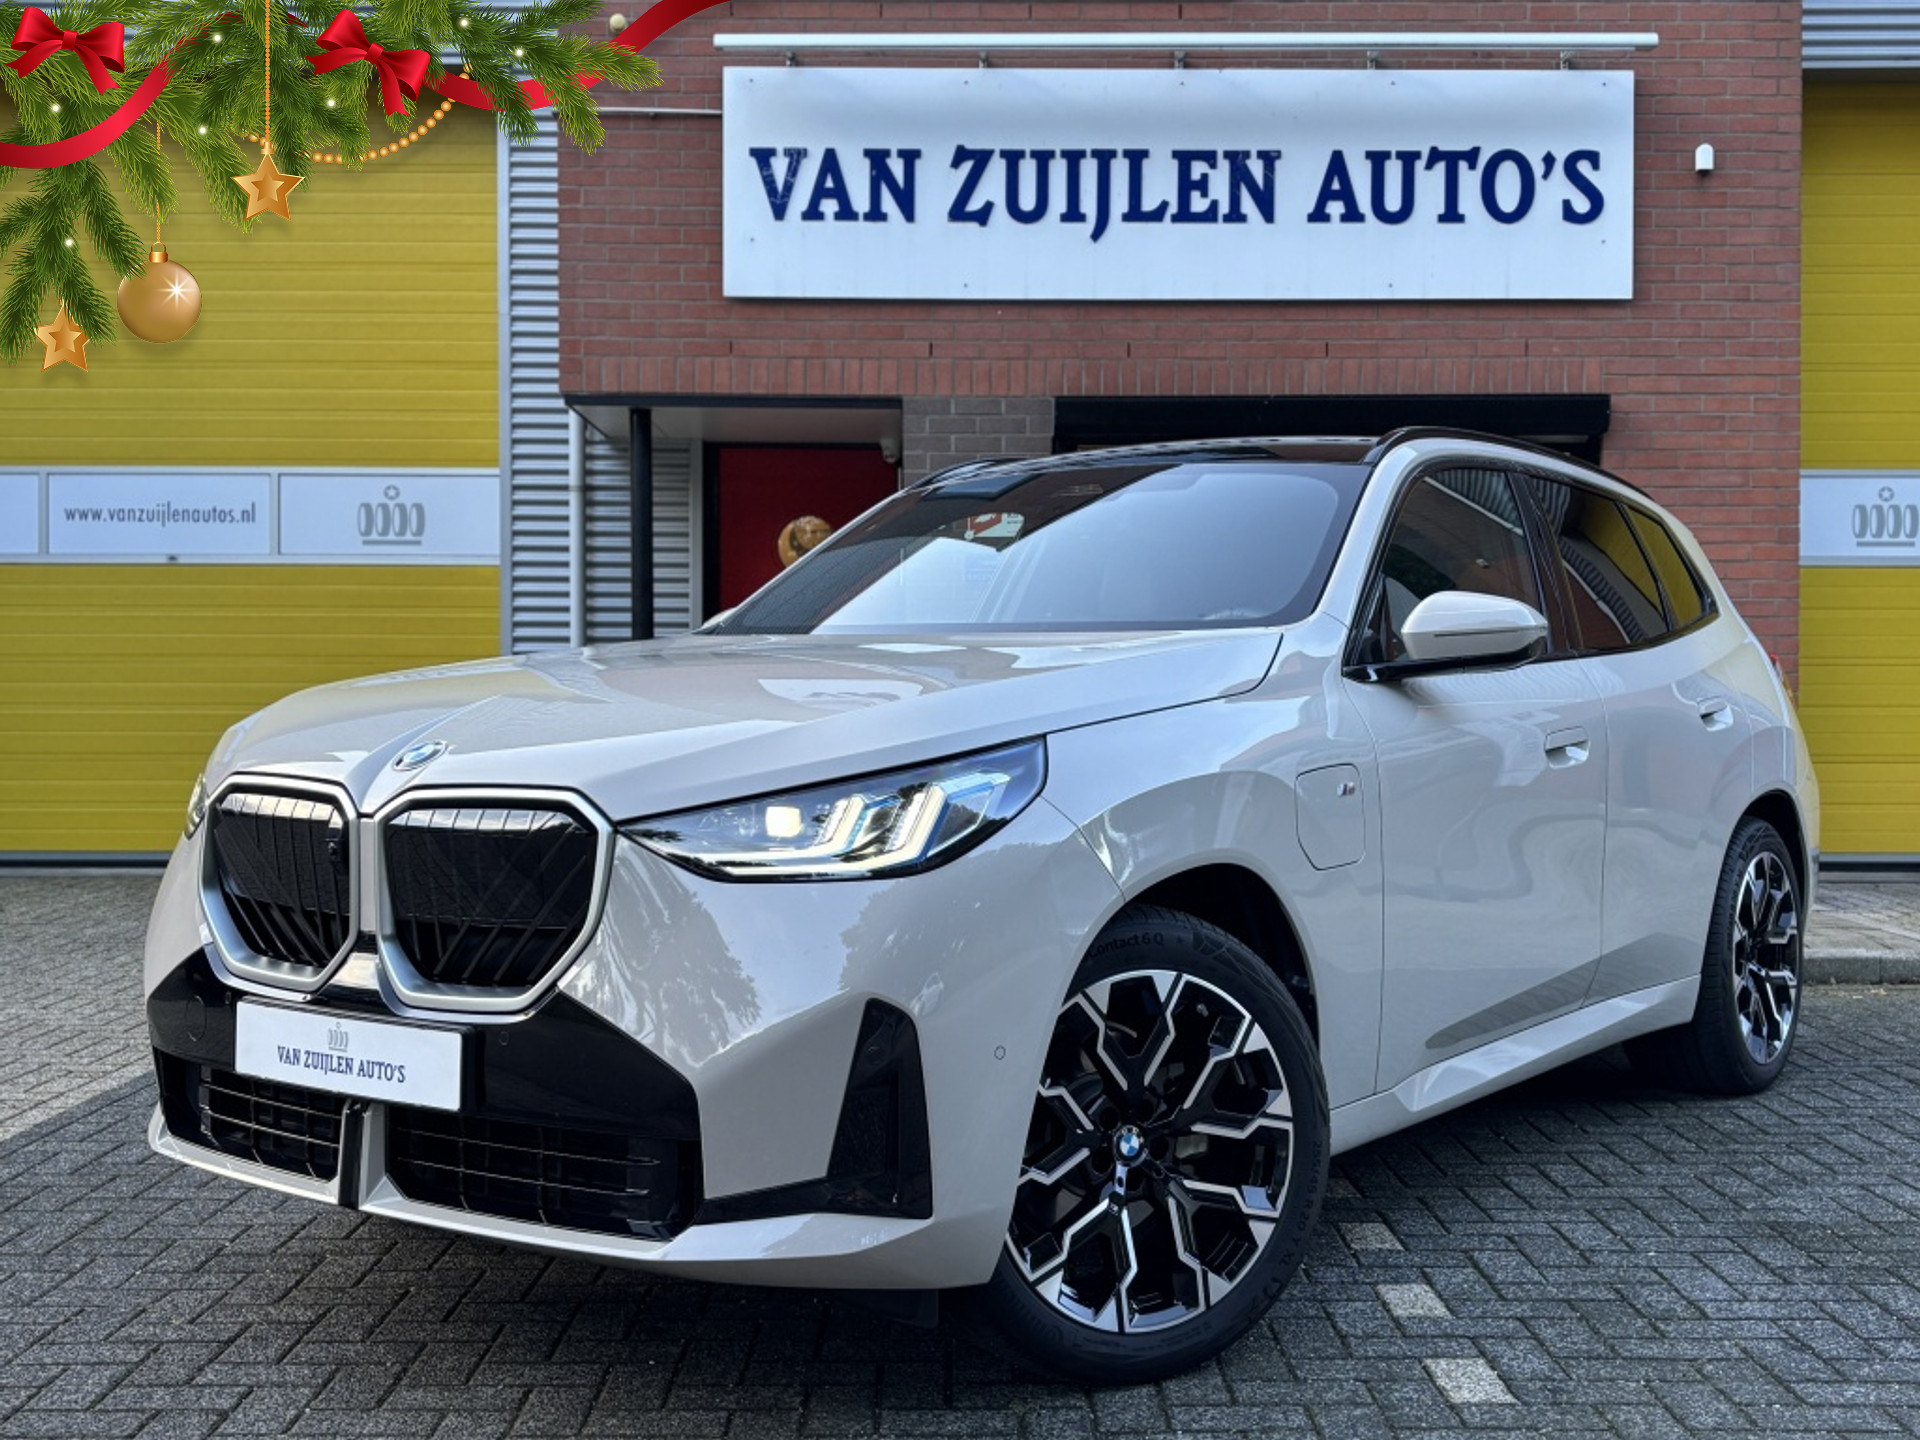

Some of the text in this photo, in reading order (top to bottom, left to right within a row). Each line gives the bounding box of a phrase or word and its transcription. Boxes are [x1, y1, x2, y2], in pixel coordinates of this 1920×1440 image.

[749, 144, 1606, 243] VAN ZUIJLEN AUTO'S
[64, 501, 256, 528] www.vanzuijlenautos.nl
[277, 1046, 406, 1083] VAN ZUIJLEN AUTO'S
